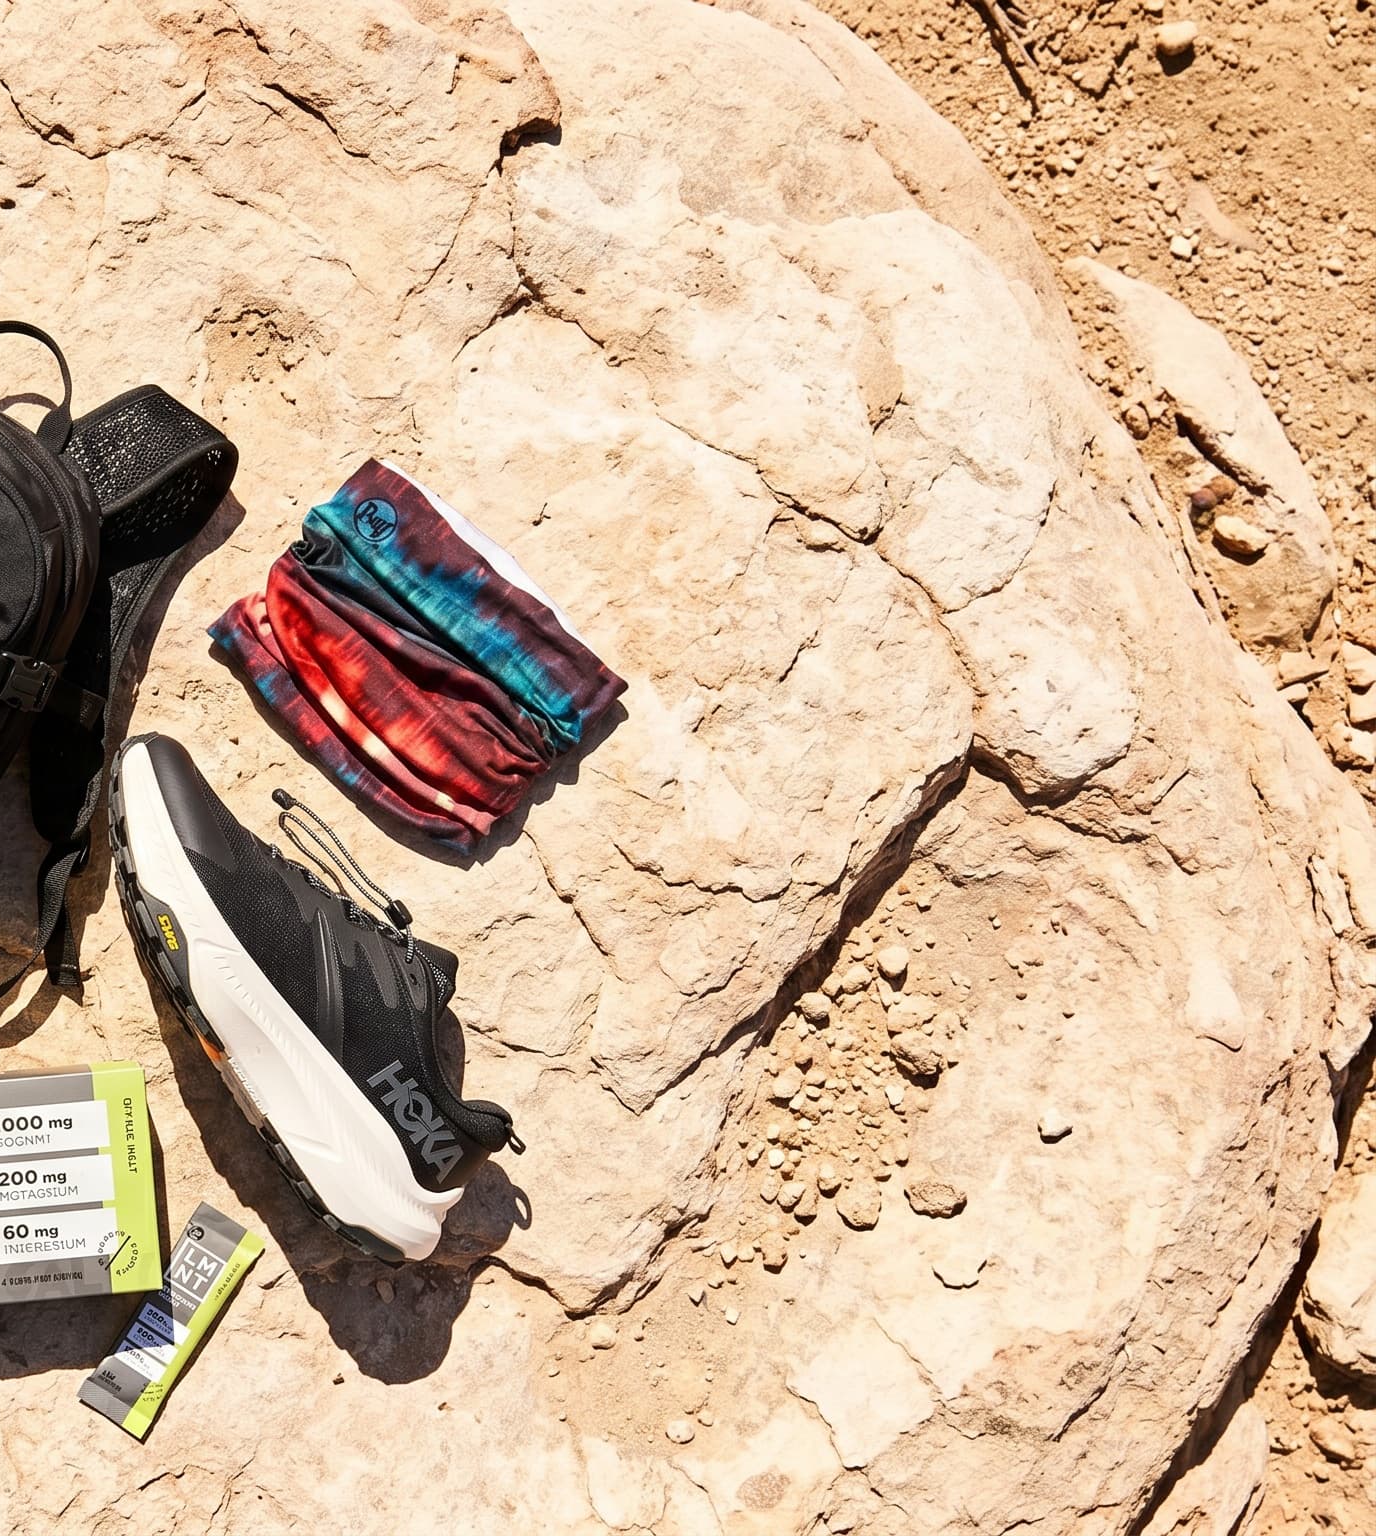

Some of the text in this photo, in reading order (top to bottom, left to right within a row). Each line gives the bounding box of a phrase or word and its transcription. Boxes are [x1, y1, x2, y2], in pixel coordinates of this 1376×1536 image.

[48, 1117, 73, 1130] mg
[366, 1060, 464, 1184] HOKA
[42, 1172, 67, 1185] mg
[3, 1223, 59, 1240] 60 mg
[184, 1247, 218, 1277] LM
[174, 1263, 209, 1290] NT
